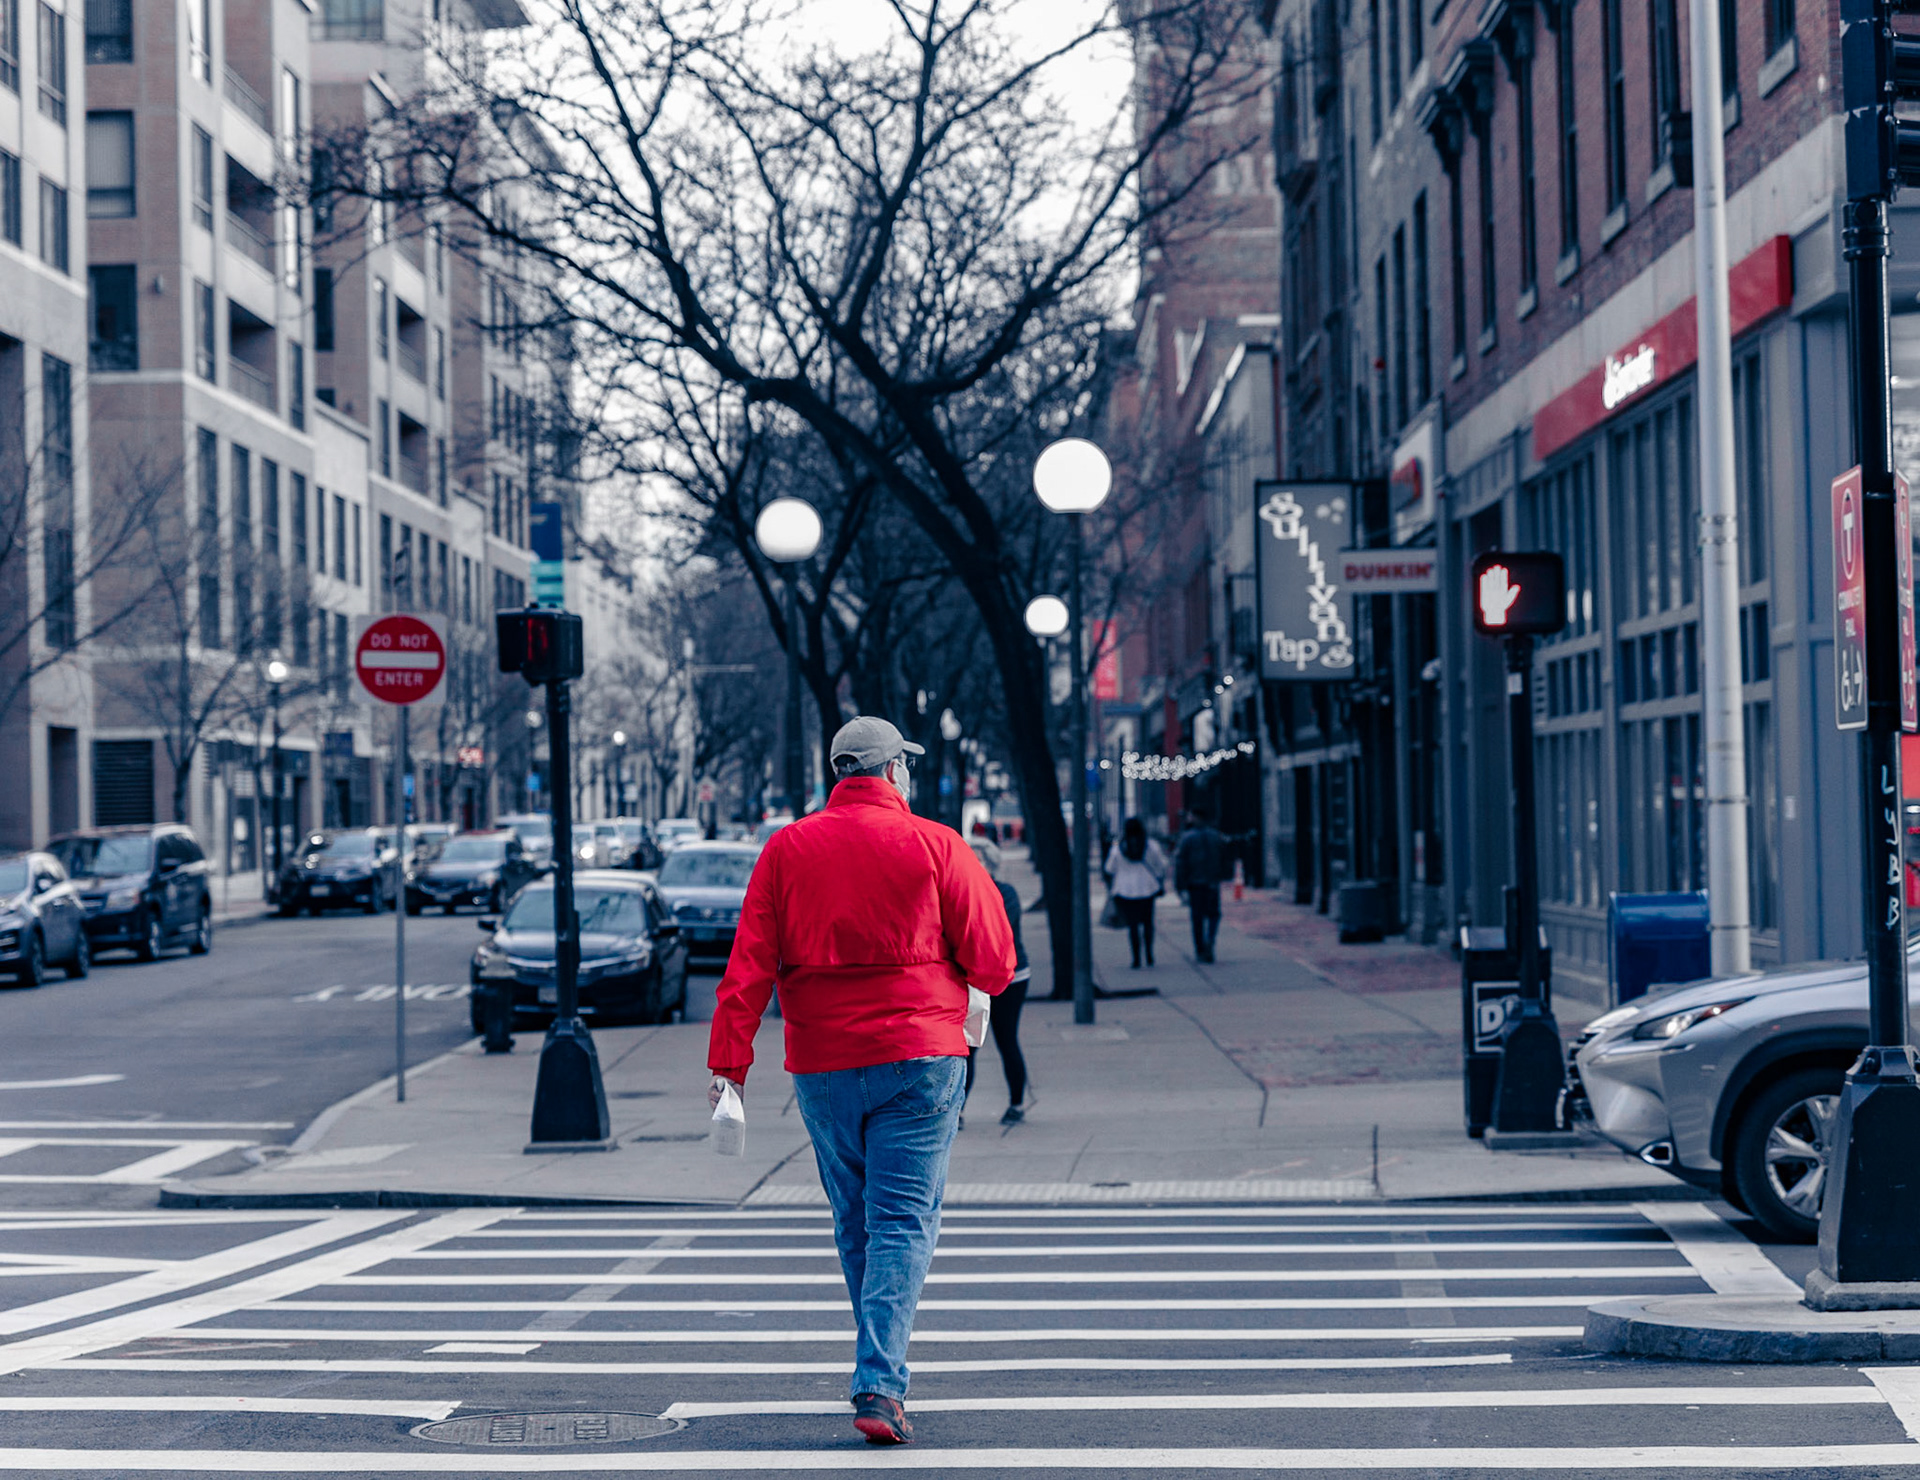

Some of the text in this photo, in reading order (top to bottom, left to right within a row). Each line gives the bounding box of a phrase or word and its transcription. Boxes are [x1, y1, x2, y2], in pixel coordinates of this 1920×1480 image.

[371, 633, 429, 648] DO NOT
[1263, 630, 1321, 671] Tap
[374, 671, 424, 687] ENTER
